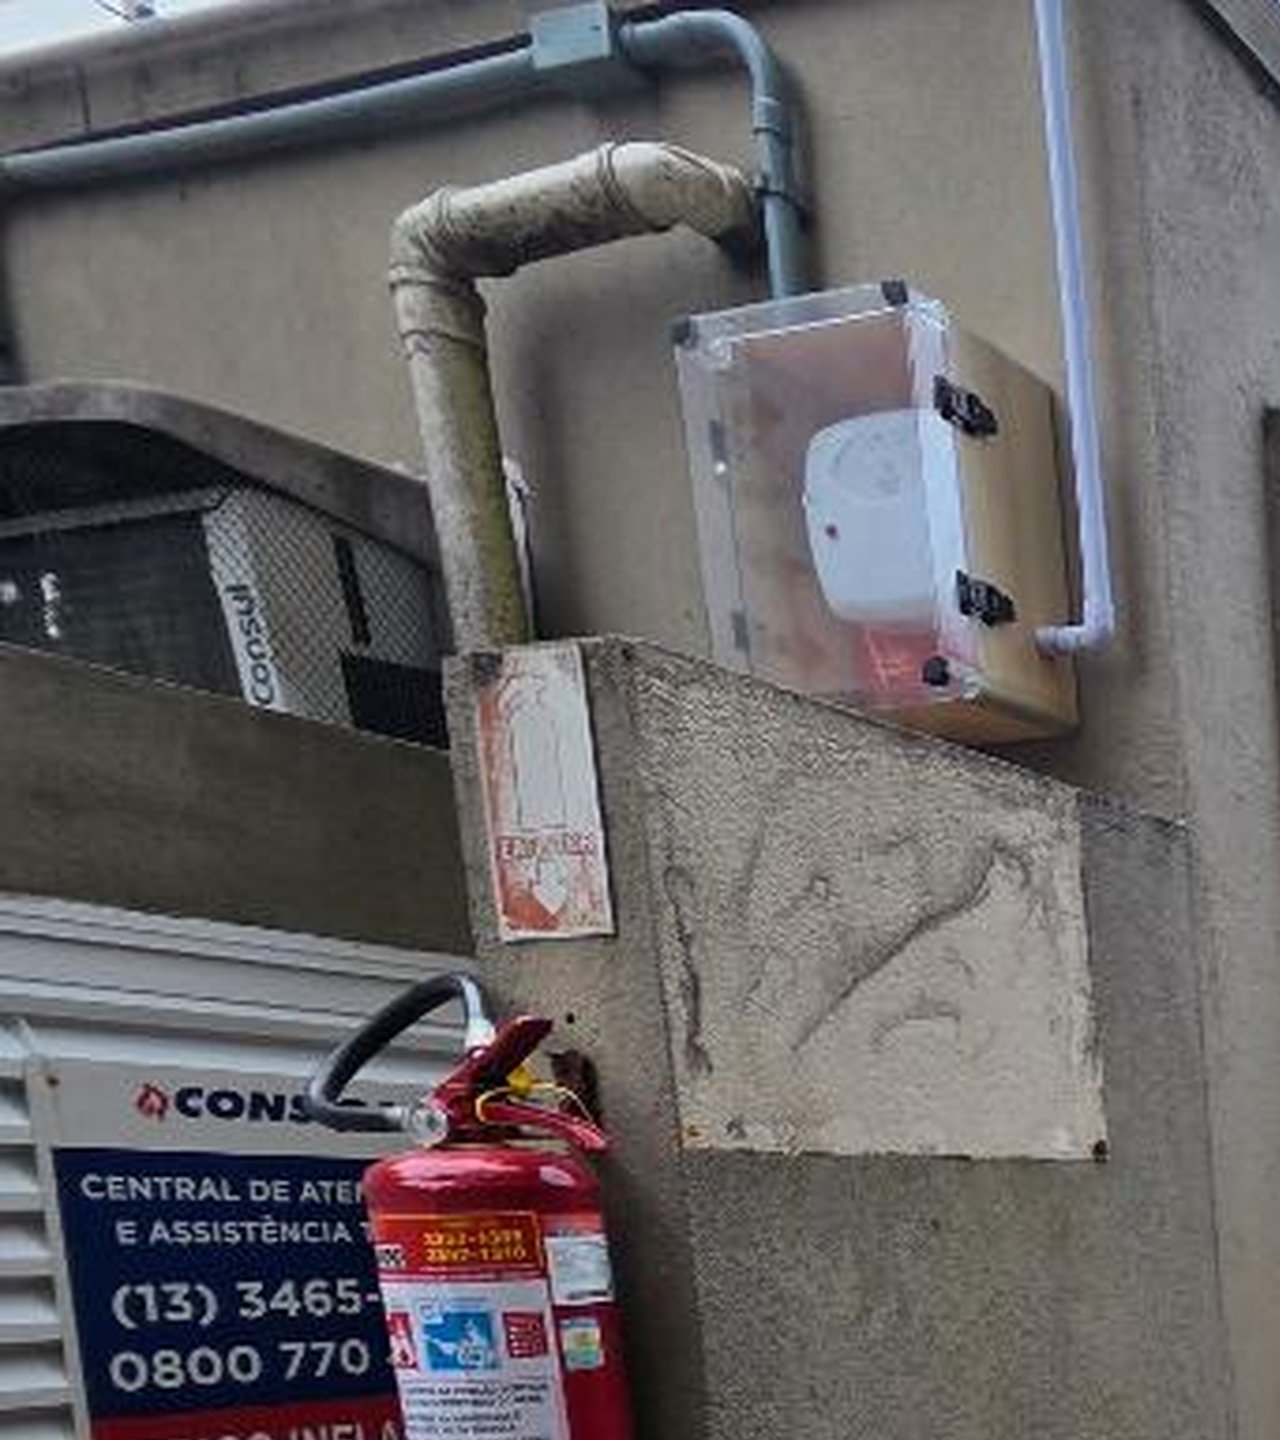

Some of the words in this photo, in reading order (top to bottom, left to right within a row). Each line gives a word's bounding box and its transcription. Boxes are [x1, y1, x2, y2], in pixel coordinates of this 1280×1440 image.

[224, 584, 275, 705] Consul
[80, 1173, 241, 1202] CENTRAL
[249, 1179, 291, 1202] DE
[115, 1222, 137, 1245] E
[149, 1215, 353, 1244] ASSISTÊNCIA
[111, 1281, 219, 1329] (13)
[235, 1279, 380, 1319] 3465-
[109, 1345, 263, 1392] 0800
[278, 1338, 370, 1380] 770
